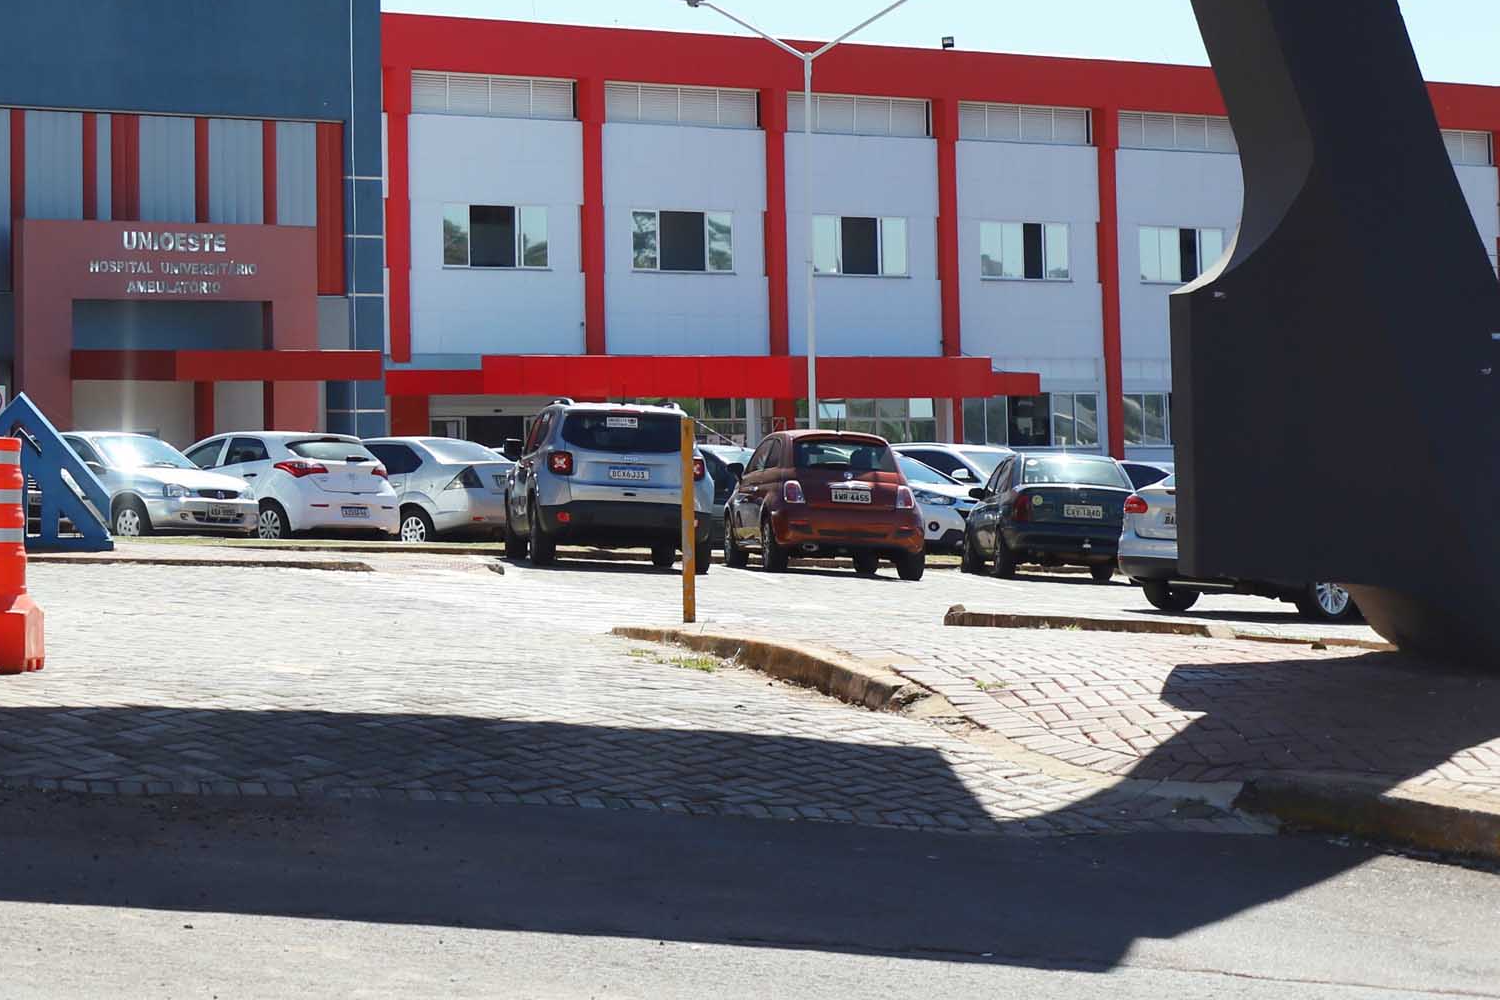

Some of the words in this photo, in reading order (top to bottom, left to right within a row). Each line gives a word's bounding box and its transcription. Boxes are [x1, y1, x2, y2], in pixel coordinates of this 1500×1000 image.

[123, 231, 227, 252] UNIOESTE
[89, 260, 153, 274] HOSPITAL
[160, 260, 257, 276] UNIVERSITÁRIO
